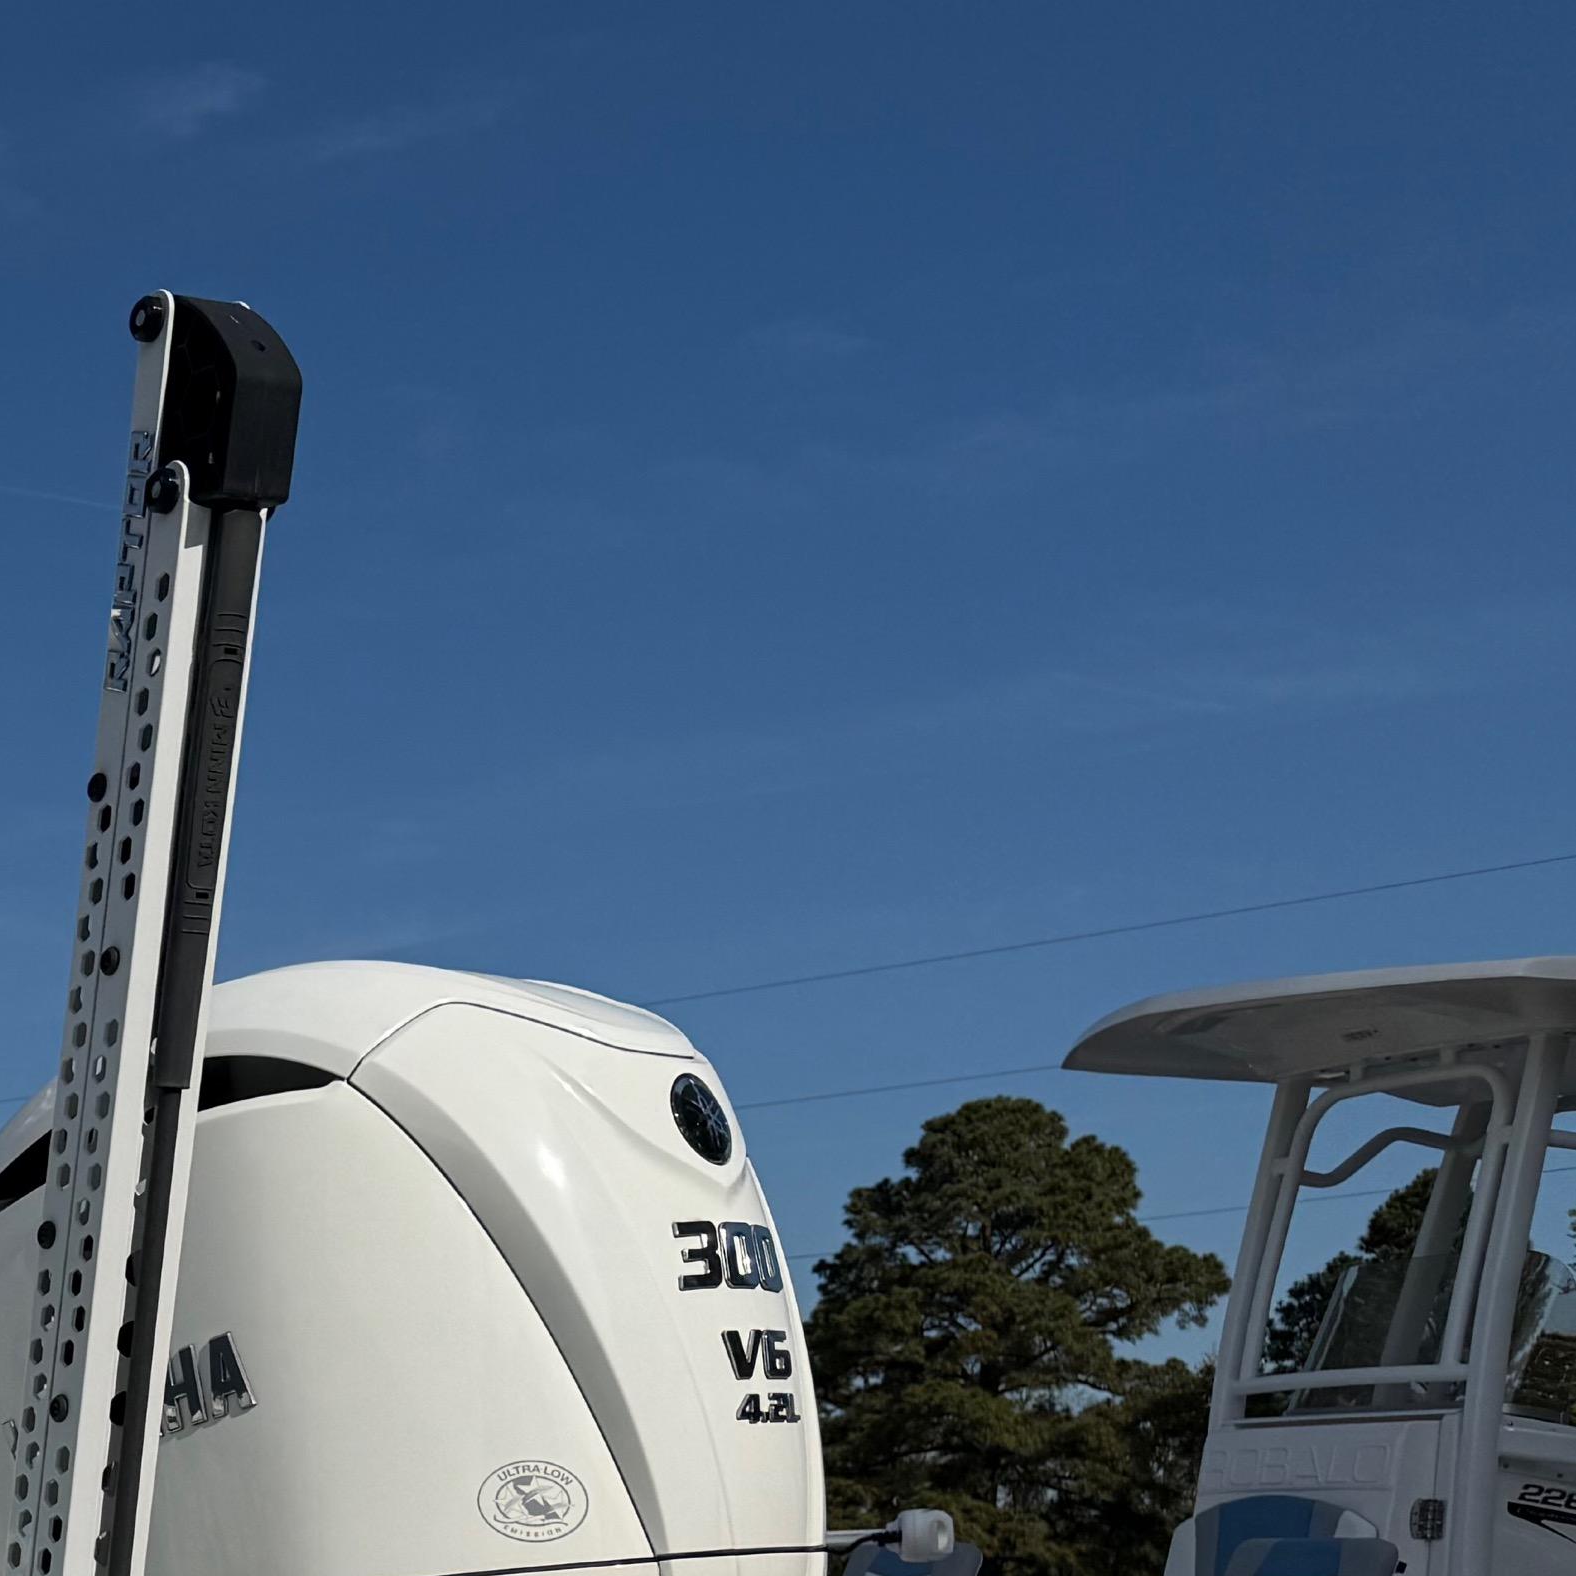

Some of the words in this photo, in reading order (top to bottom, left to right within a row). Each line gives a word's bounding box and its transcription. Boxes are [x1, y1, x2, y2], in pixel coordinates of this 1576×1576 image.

[104, 431, 154, 692] RAPTOR
[672, 1220, 784, 1293] 300
[721, 1329, 792, 1380] V6
[736, 1392, 801, 1424] 4.2L
